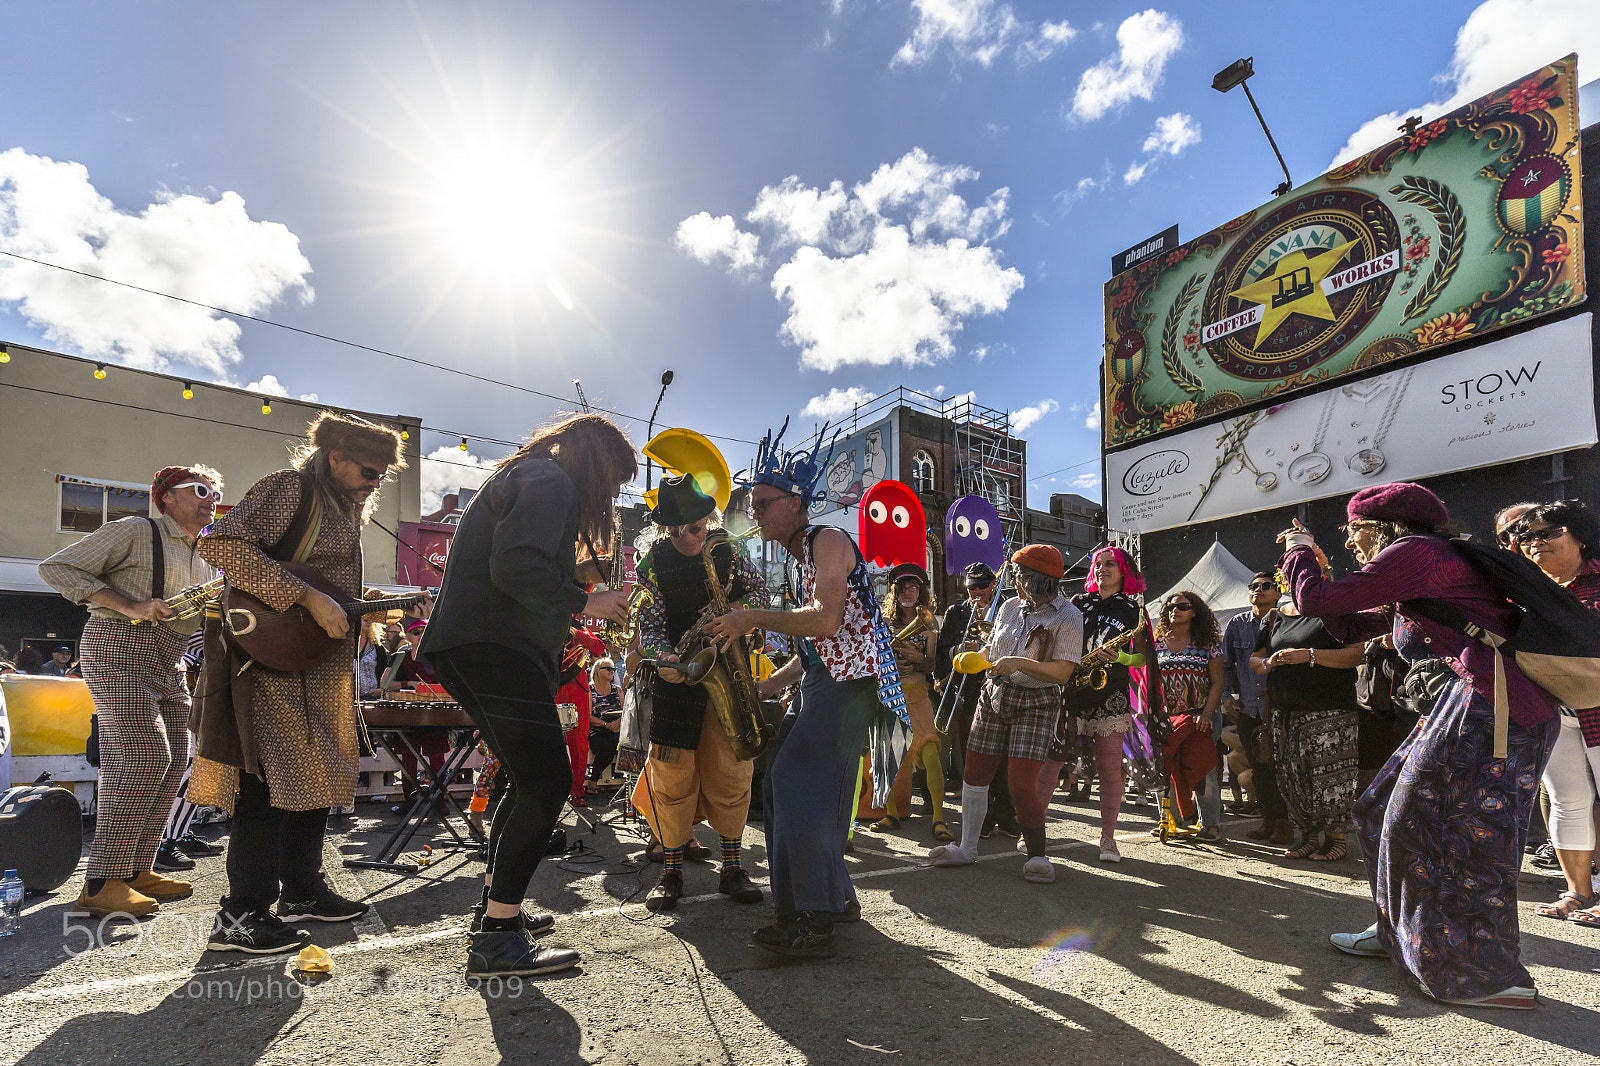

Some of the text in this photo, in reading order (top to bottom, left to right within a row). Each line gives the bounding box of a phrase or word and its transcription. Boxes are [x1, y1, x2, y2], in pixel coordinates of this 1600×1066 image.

[1244, 194, 1335, 246] HOT AIR
[1124, 236, 1164, 268] phantom
[1247, 229, 1337, 279] HAVANA
[1206, 254, 1394, 340] COFFEE WORKS
[1243, 333, 1348, 375] ROASTED
[1272, 335, 1290, 345] EST
[1440, 360, 1542, 405] STOW
[1455, 390, 1526, 413] LOCKETS
[1447, 419, 1536, 448] precious stories
[1122, 516, 1136, 524] Open
[1141, 512, 1154, 520] days
[1147, 503, 1164, 512] Street
